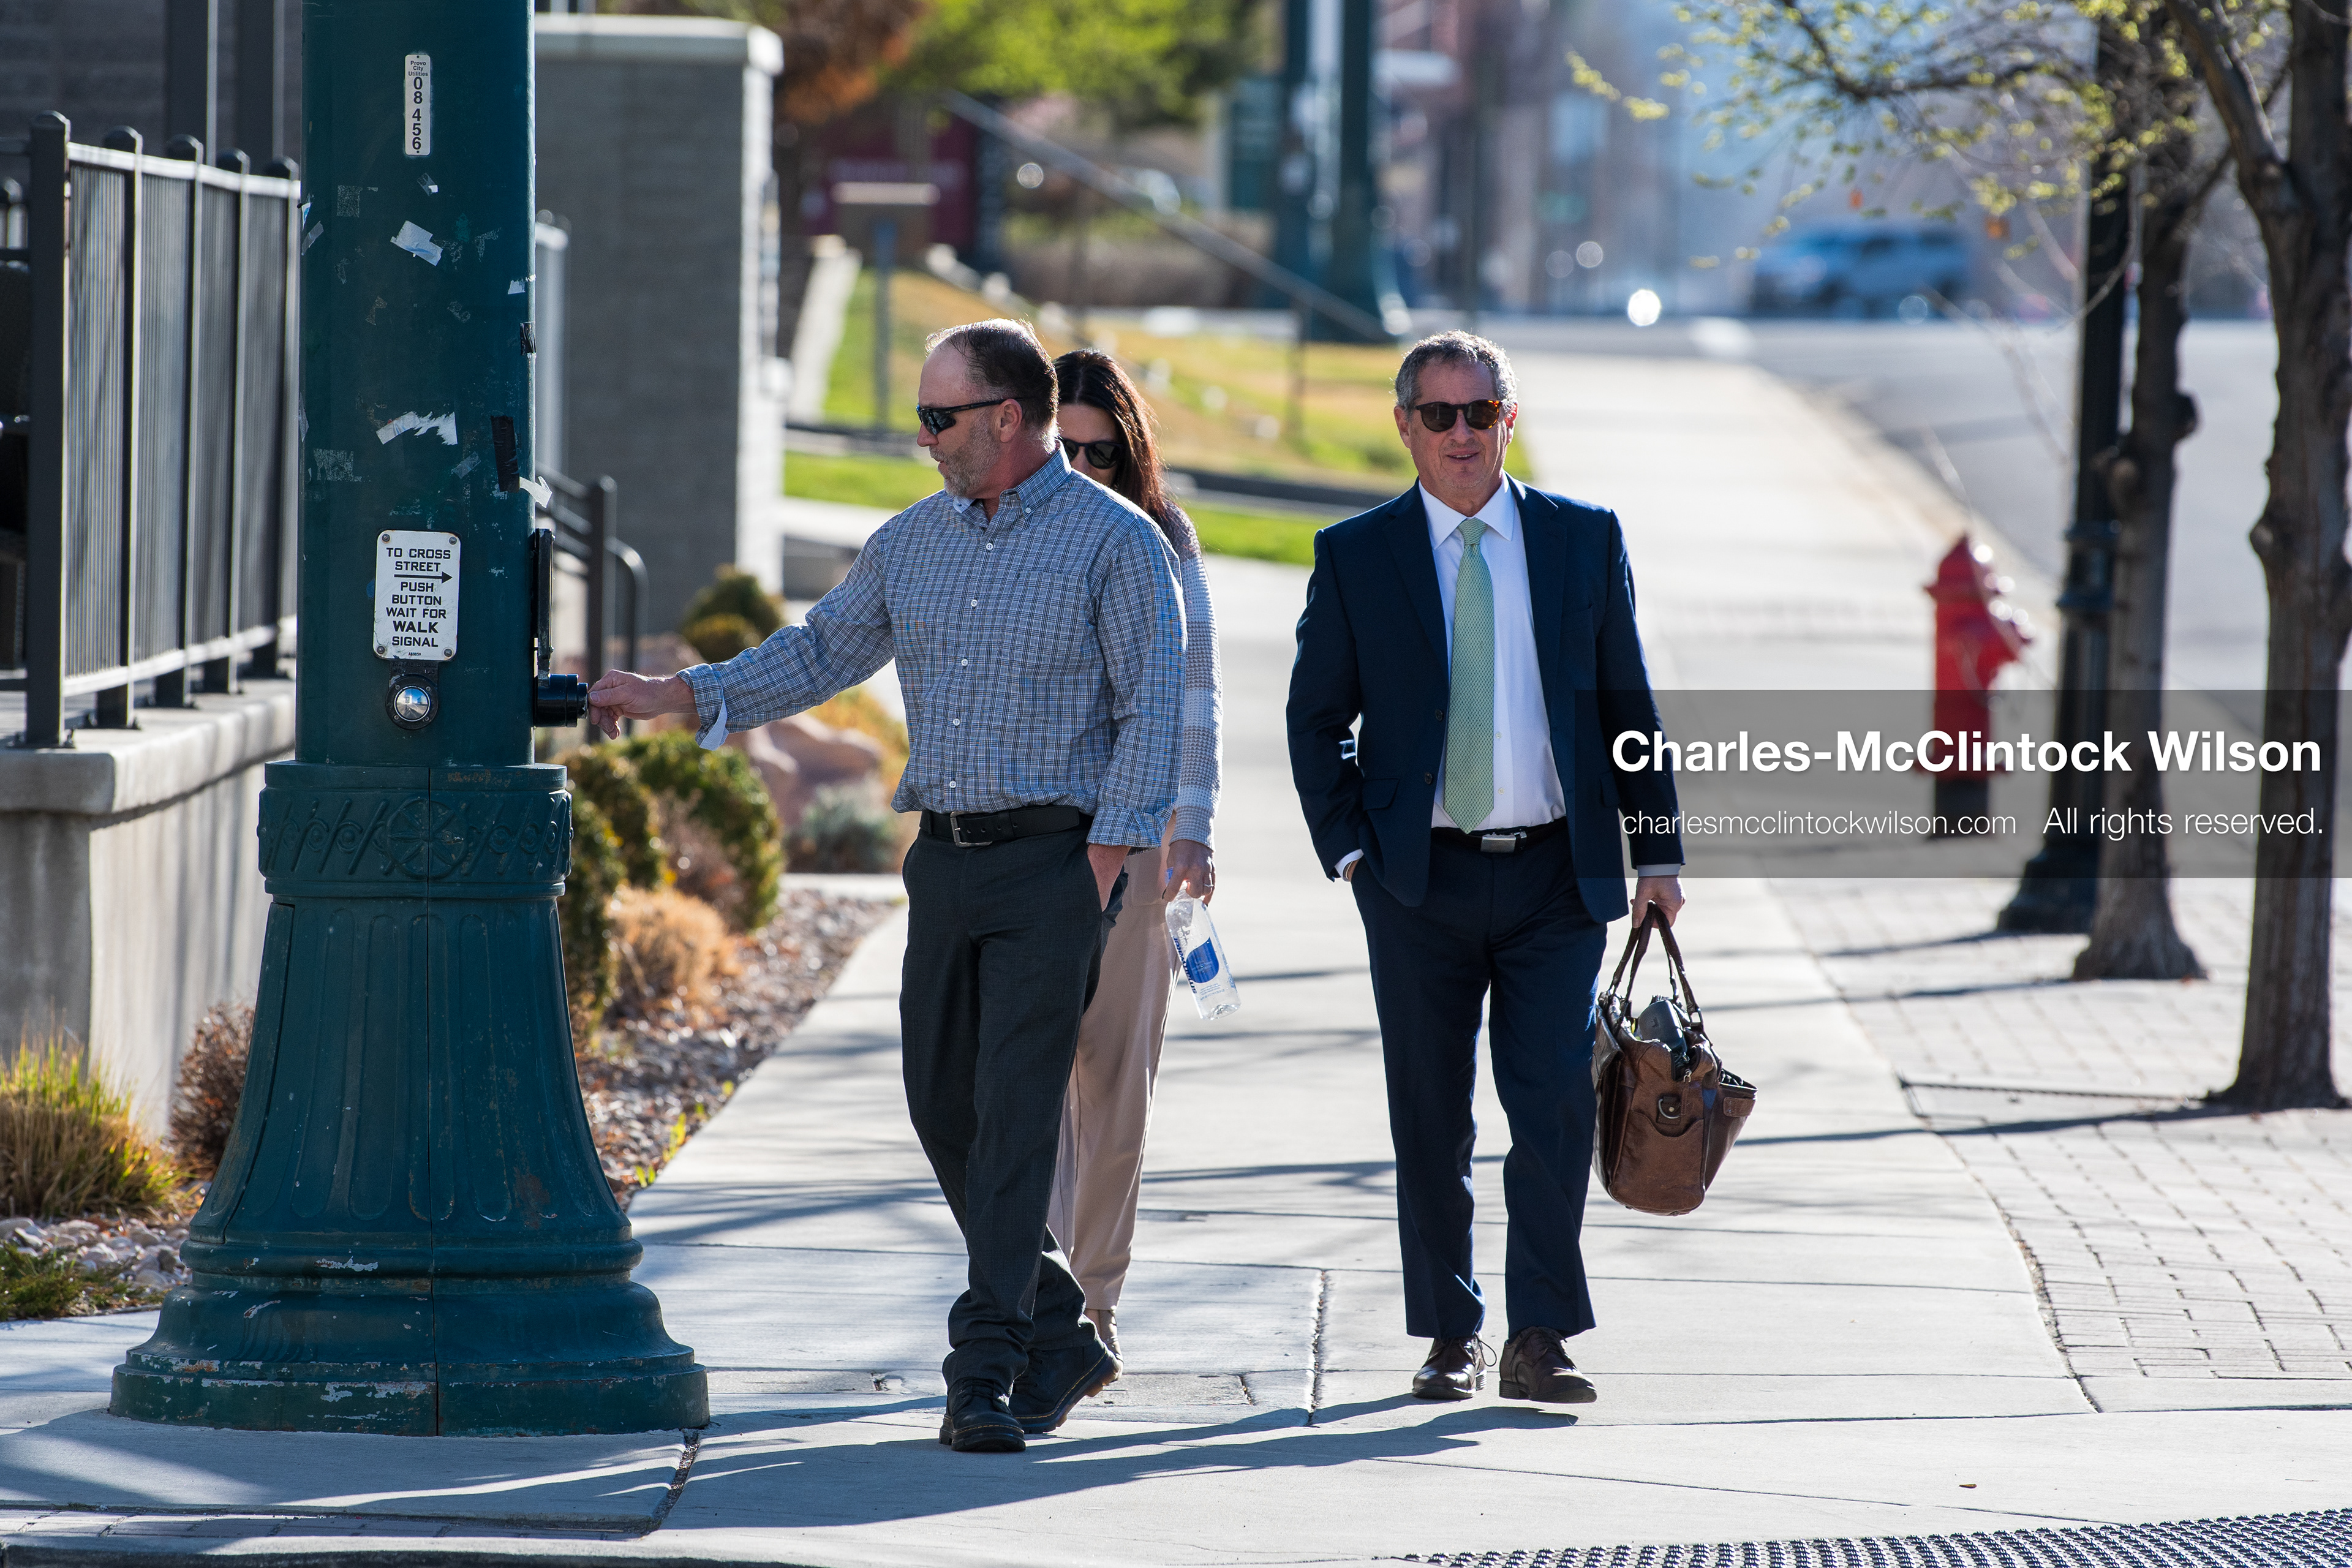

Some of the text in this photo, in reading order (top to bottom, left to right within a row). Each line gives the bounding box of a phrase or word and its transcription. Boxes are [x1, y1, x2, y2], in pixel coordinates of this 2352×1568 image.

[386, 547, 451, 559] TO CROSS
[394, 560, 441, 572] STREET
[400, 581, 434, 592] PUSH
[391, 594, 442, 606] BUTTON
[385, 607, 447, 619] WAIT FOR
[393, 620, 439, 634] WALK
[391, 636, 439, 647] SIGNAL
